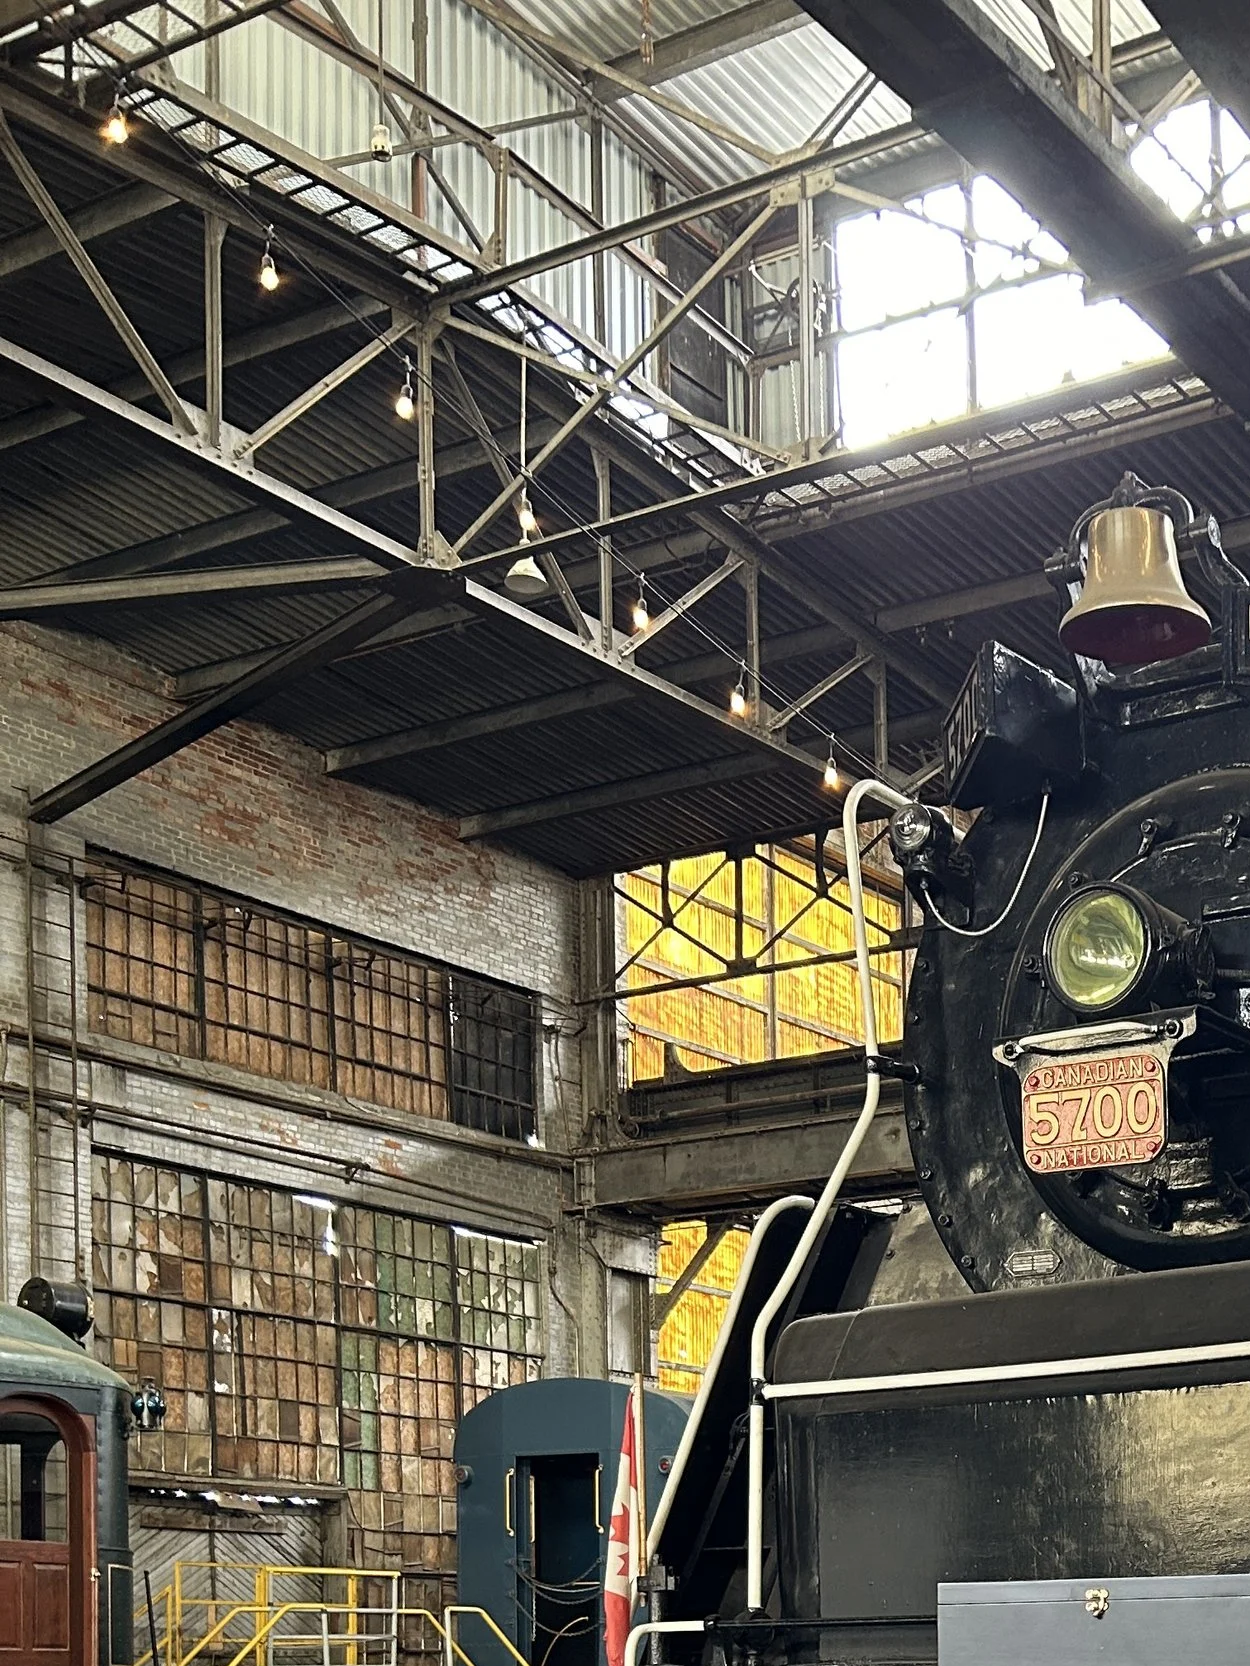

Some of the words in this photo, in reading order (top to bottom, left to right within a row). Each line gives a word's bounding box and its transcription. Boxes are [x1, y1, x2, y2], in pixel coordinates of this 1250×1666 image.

[1040, 1056, 1145, 1089] CANADIAN
[1028, 1081, 1158, 1146] 5700
[1041, 1141, 1145, 1169] NATIONAL
